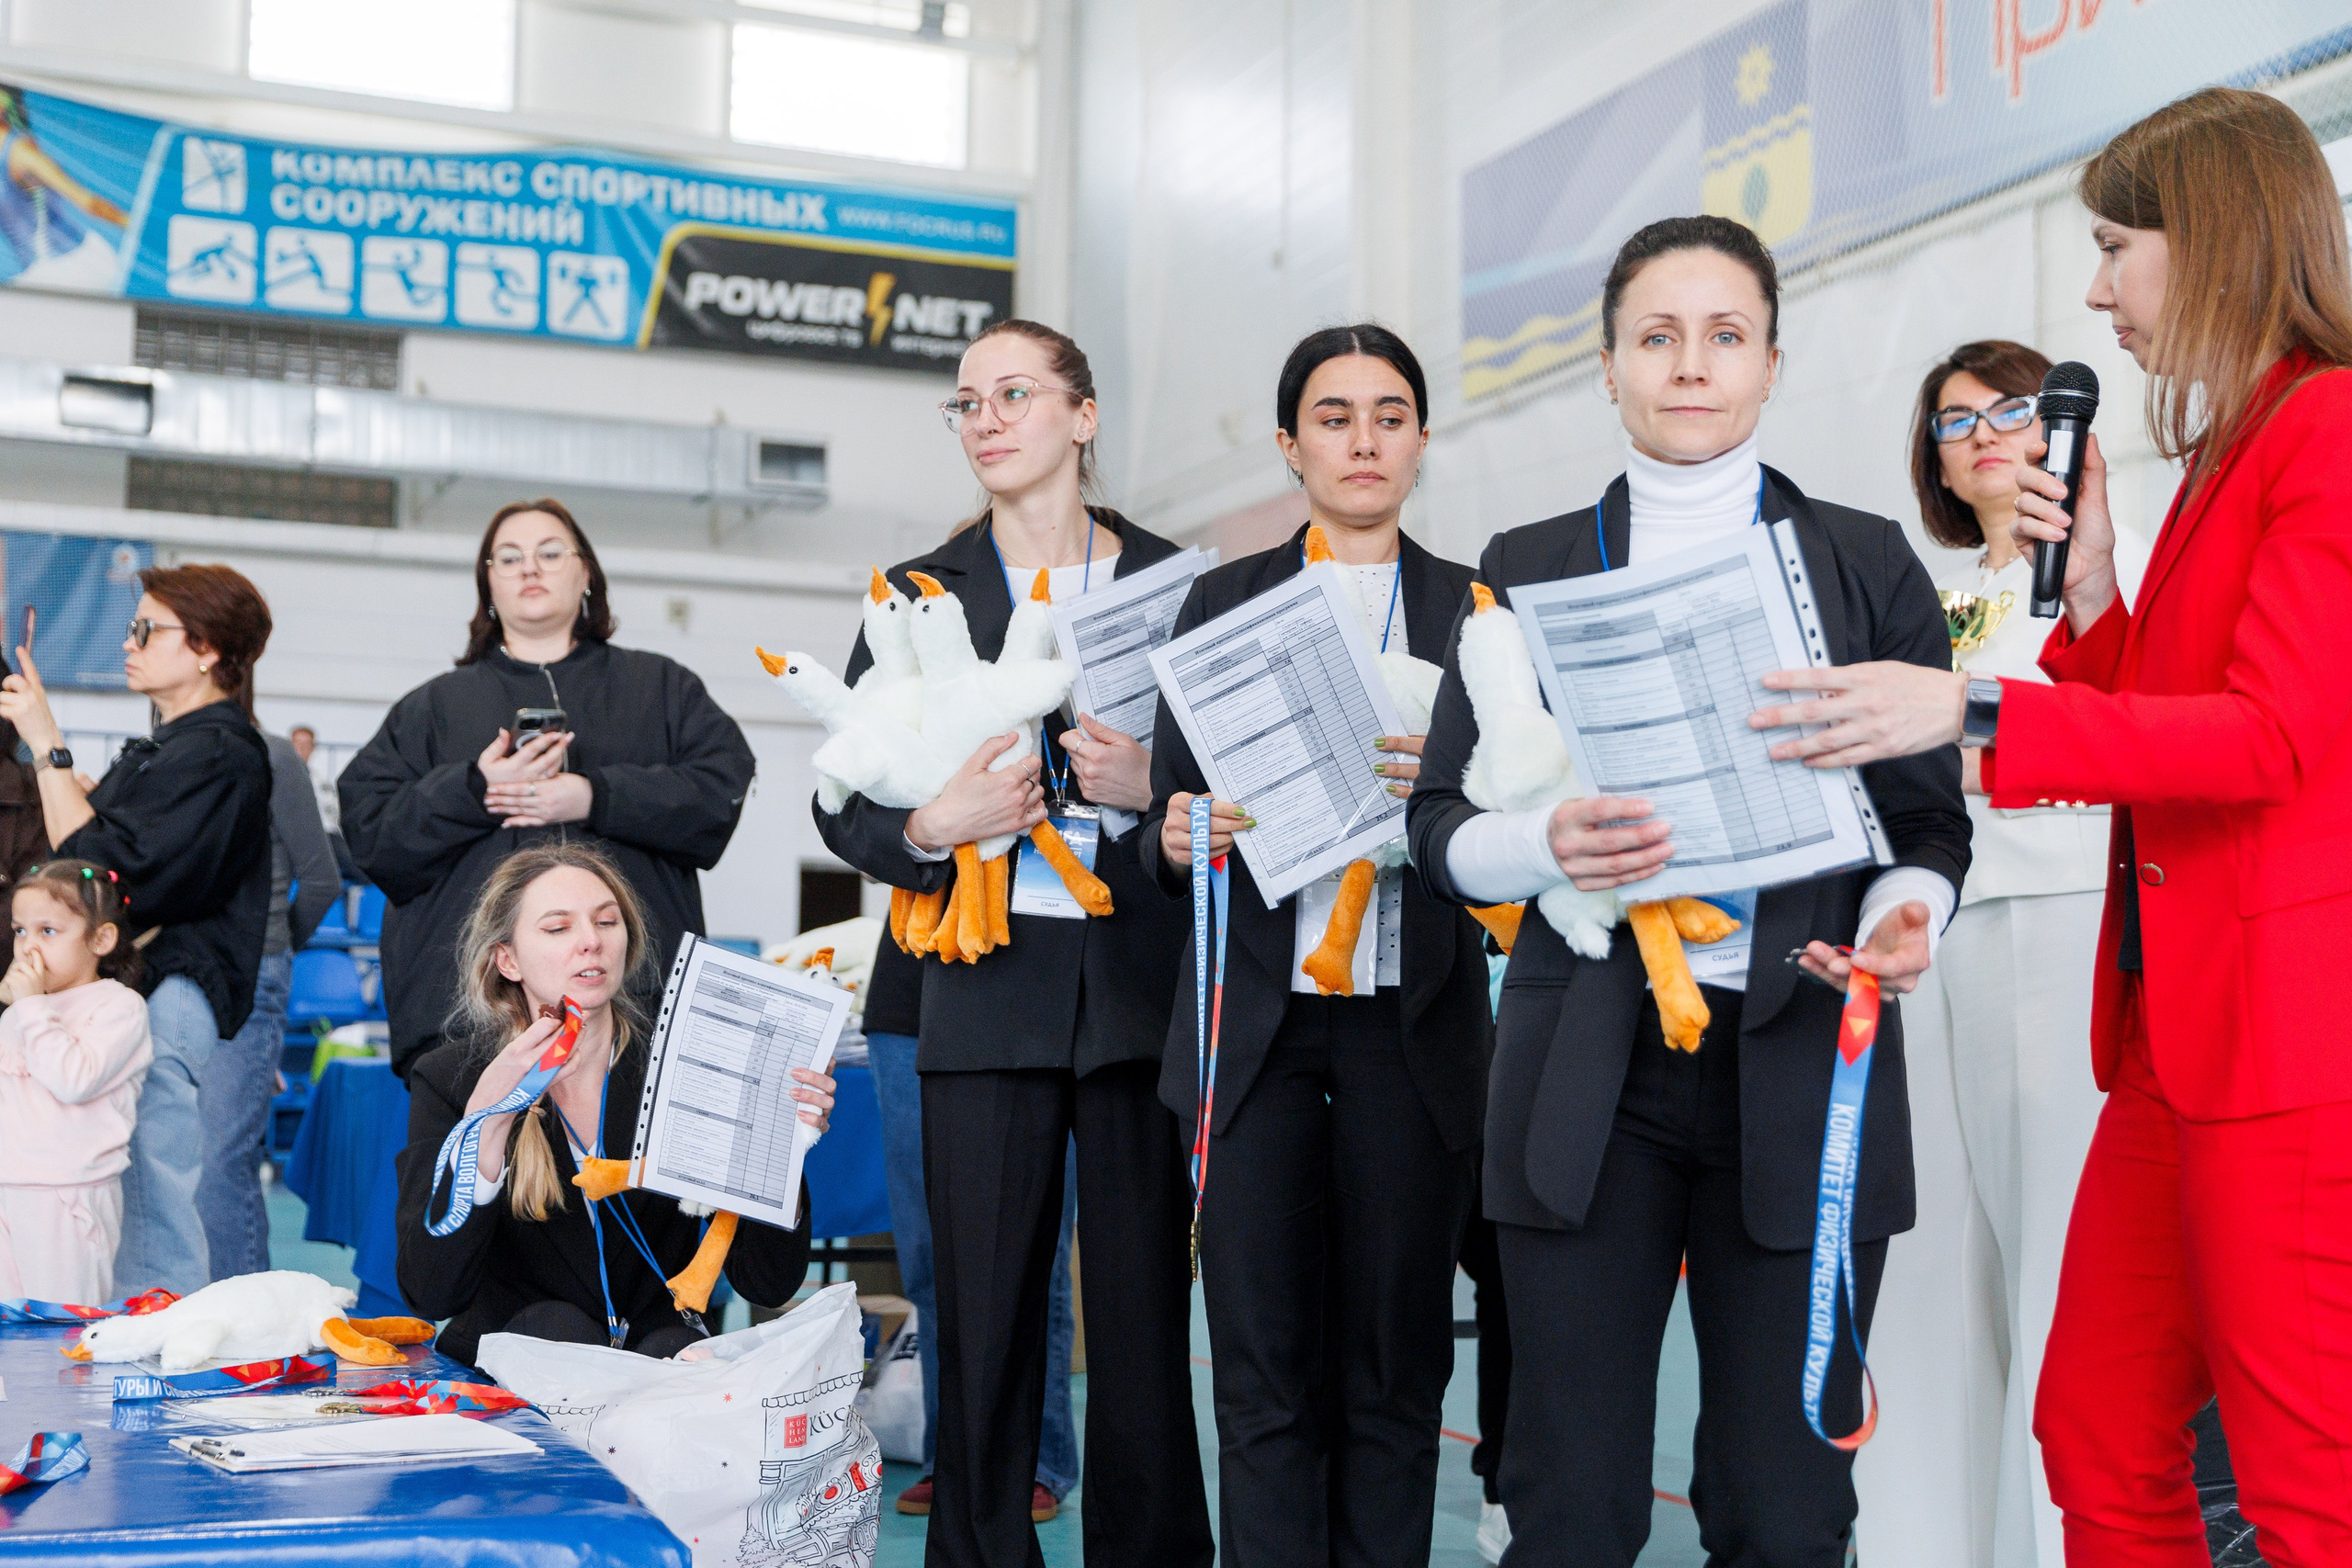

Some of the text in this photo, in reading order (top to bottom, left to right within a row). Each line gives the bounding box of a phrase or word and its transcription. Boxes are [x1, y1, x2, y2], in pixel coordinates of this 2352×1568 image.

[271, 184, 583, 246] СООРУЖЕНИЙ
[272, 150, 826, 229] КОМПЛЕКС СПОРТИВНЫХ
[685, 273, 867, 326] POWER
[891, 292, 993, 338] NET
[1195, 643, 1216, 656] Итоговый
[1193, 876, 1207, 982] ФИЗИЧЕСКОЙ
[1712, 951, 1739, 963] СУДЬЯ
[1821, 1102, 1857, 1201] КОМИТЕТ
[450, 1185, 475, 1229] СПОРТА
[1810, 1201, 1841, 1342] ФИЗИЧЕСКОЙ
[809, 1406, 852, 1437] KÜC
